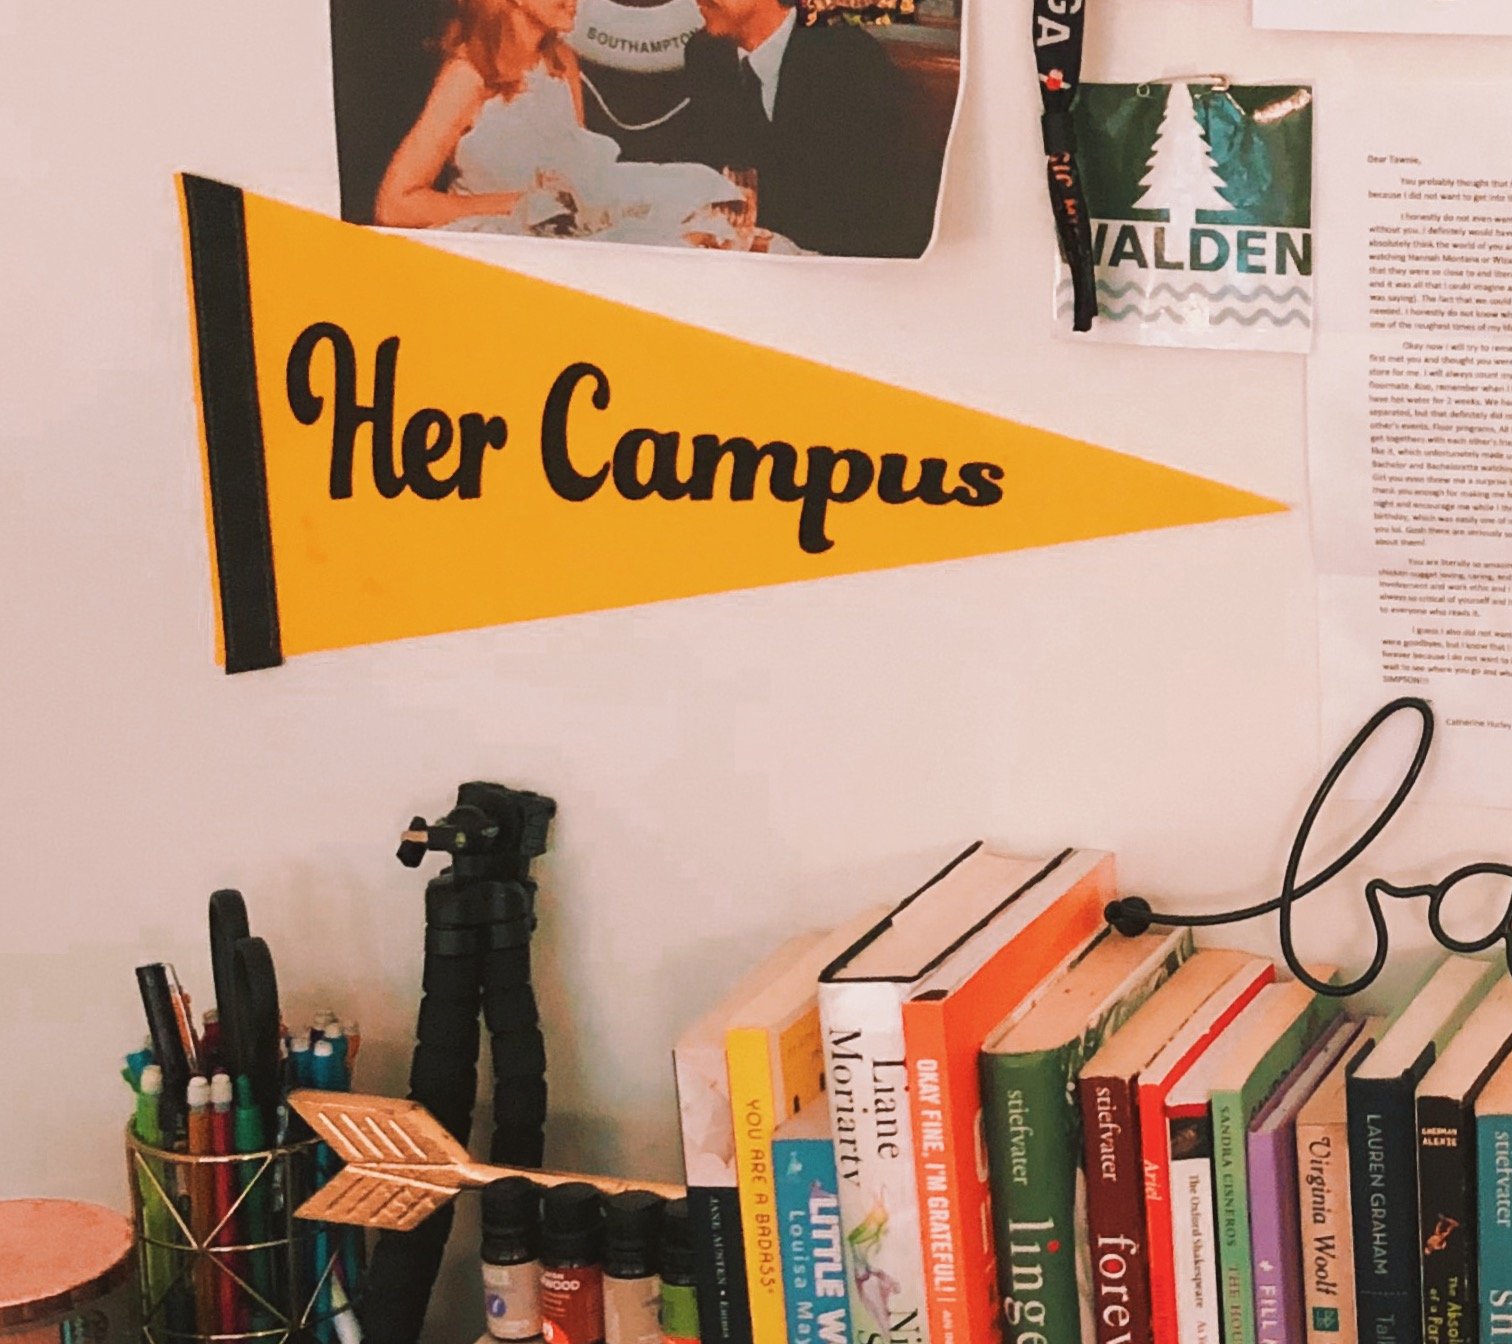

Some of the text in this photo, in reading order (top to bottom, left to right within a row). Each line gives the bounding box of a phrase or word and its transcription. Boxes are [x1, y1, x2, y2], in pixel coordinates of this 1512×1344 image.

[285, 320, 1005, 555] Her Campus
[744, 1098, 766, 1141] YOU
[829, 1028, 866, 1188] Moriarty
[871, 1058, 906, 1161] Liane
[1006, 1089, 1029, 1185] stiefvater
[1094, 1086, 1120, 1182] stiefvater
[1220, 1106, 1235, 1167] SANDRA
[750, 1147, 769, 1185] ARE
[916, 1059, 957, 1292] OKAY FINE, I'M GRATEFUL!
[1144, 1159, 1163, 1202] Ariel
[1366, 1114, 1385, 1187] LAUREN
[755, 1192, 771, 1206] A
[1222, 1174, 1240, 1247] CISNEROS
[1306, 1135, 1337, 1294] Virginia Woolf
[1370, 1193, 1390, 1274] GRAHAM
[788, 1210, 811, 1290] Louisa
[809, 1197, 846, 1304] LITTLE
[1188, 1174, 1207, 1309] The Oxford Shakespeare
[1228, 1266, 1243, 1298] THE
[1260, 1285, 1279, 1328] FILL
[1429, 1288, 1440, 1301] of
[1430, 1305, 1438, 1313] a
[1447, 1277, 1460, 1297] The
